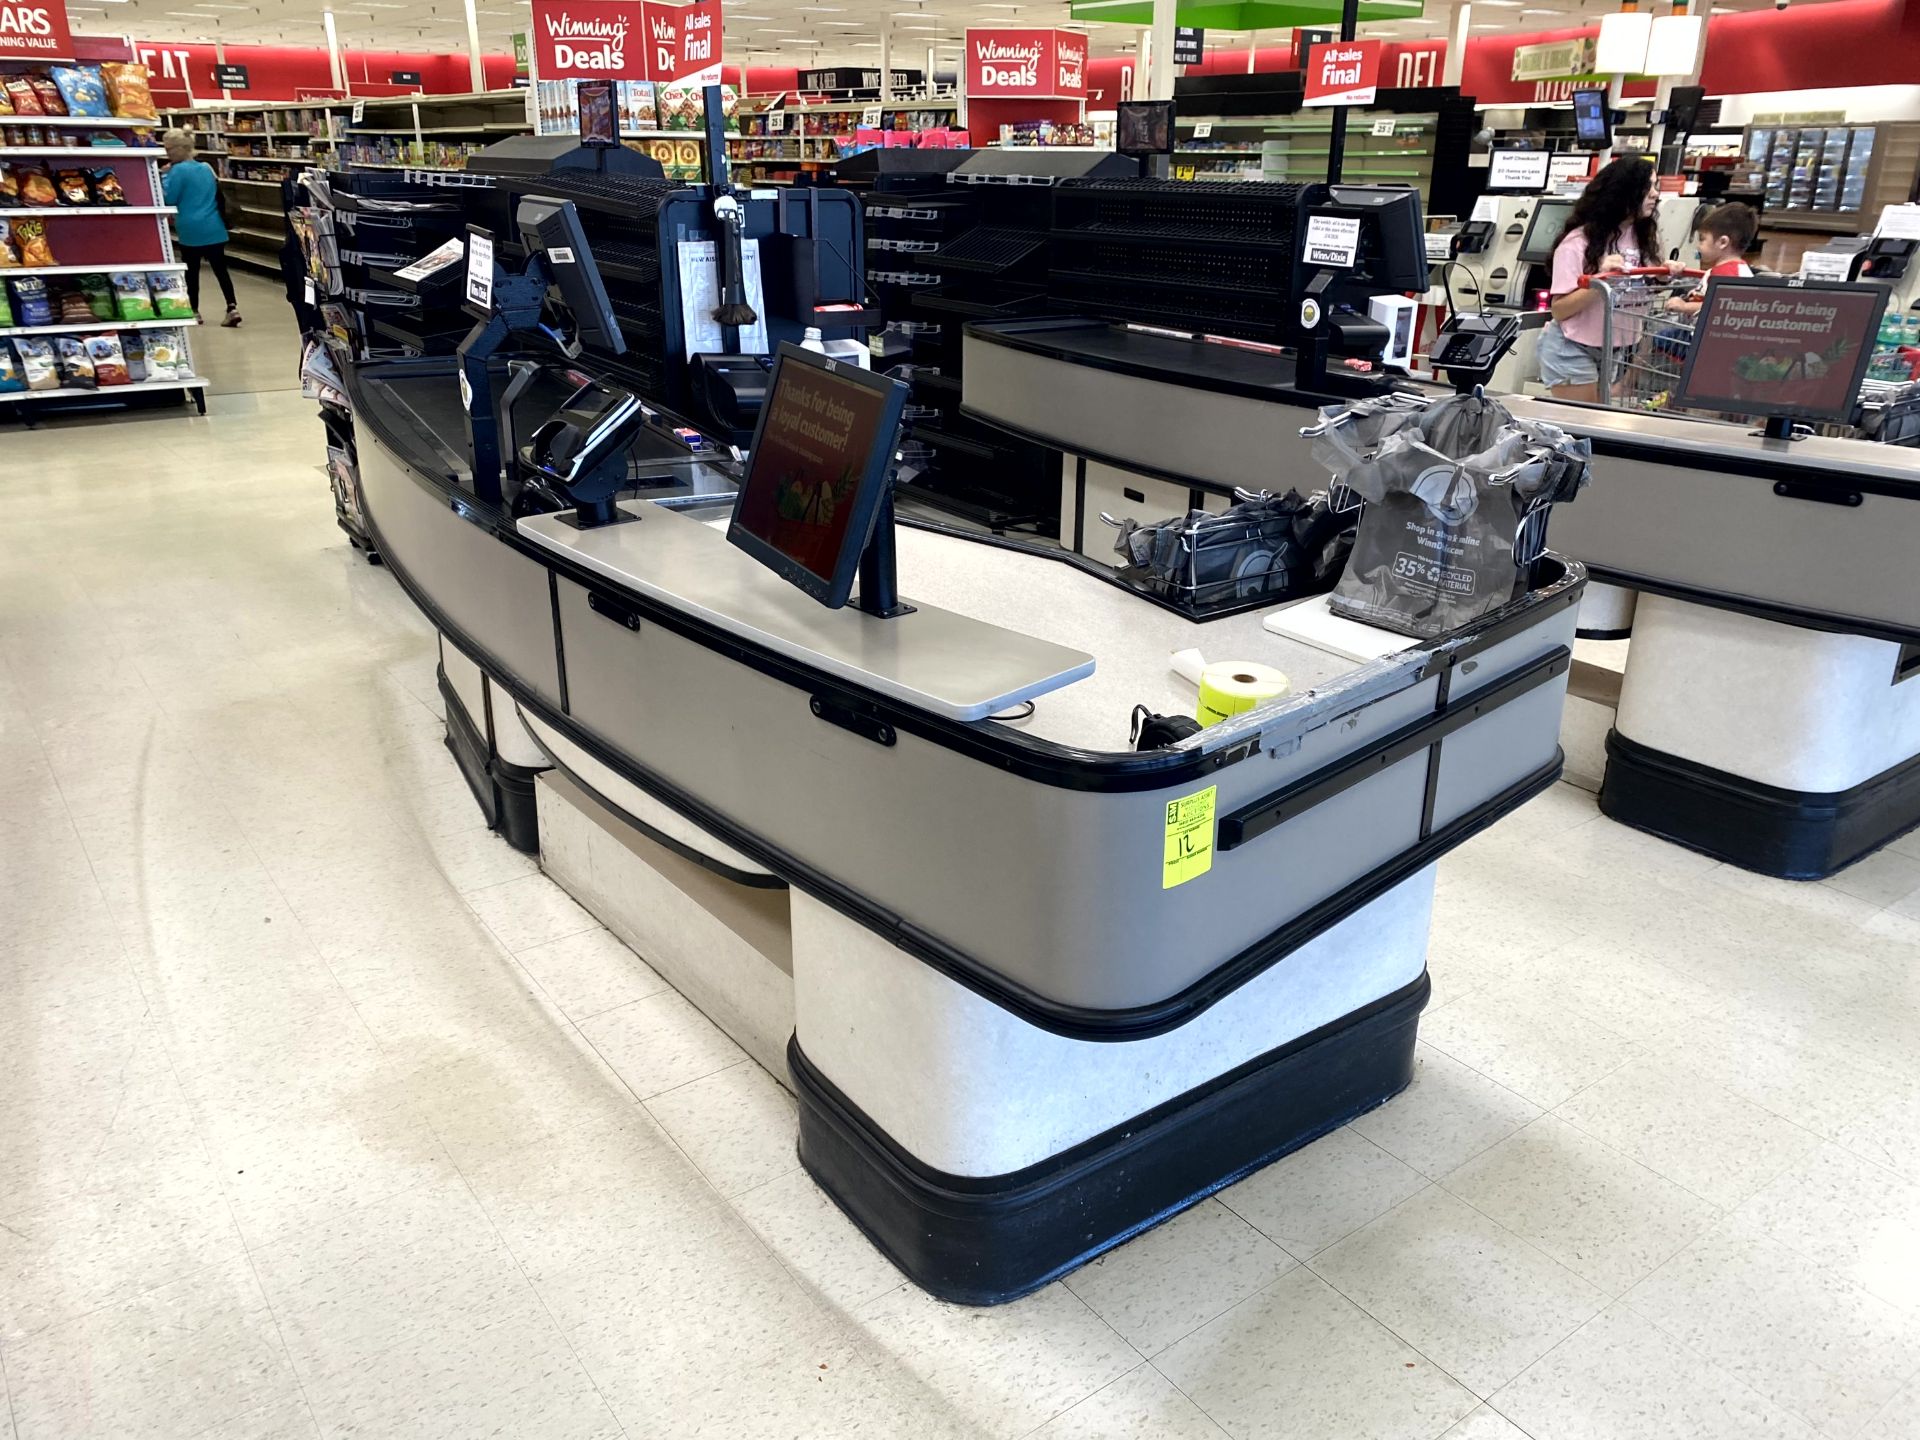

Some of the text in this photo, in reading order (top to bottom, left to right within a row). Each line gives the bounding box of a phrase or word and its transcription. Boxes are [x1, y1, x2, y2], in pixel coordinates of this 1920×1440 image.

[545, 12, 628, 51] Winning
[684, 11, 711, 31] All sales
[27, 37, 58, 49] VALUE
[684, 31, 711, 62] final
[554, 44, 625, 70] Deals
[976, 40, 1041, 72] Winning
[1057, 41, 1083, 72] Winning
[1323, 48, 1363, 63] All sales
[981, 64, 1037, 87] Deals
[1059, 66, 1082, 89] Deals
[1321, 62, 1362, 86] final
[631, 87, 650, 98] Total
[664, 90, 684, 101] Chex
[17, 219, 43, 240] Takis
[1788, 279, 1805, 288] IBM
[1718, 297, 1837, 320] Thanks for being
[1712, 314, 1832, 333] a loyal customer!
[825, 358, 837, 372] IBM
[779, 378, 855, 431] Thanks for being
[771, 407, 778, 421] a
[777, 406, 799, 433] loyal
[800, 417, 849, 452] customer!
[1406, 521, 1426, 535] Shop
[1427, 526, 1435, 536] in
[1395, 557, 1426, 577] 35%
[1179, 834, 1195, 857] 12
